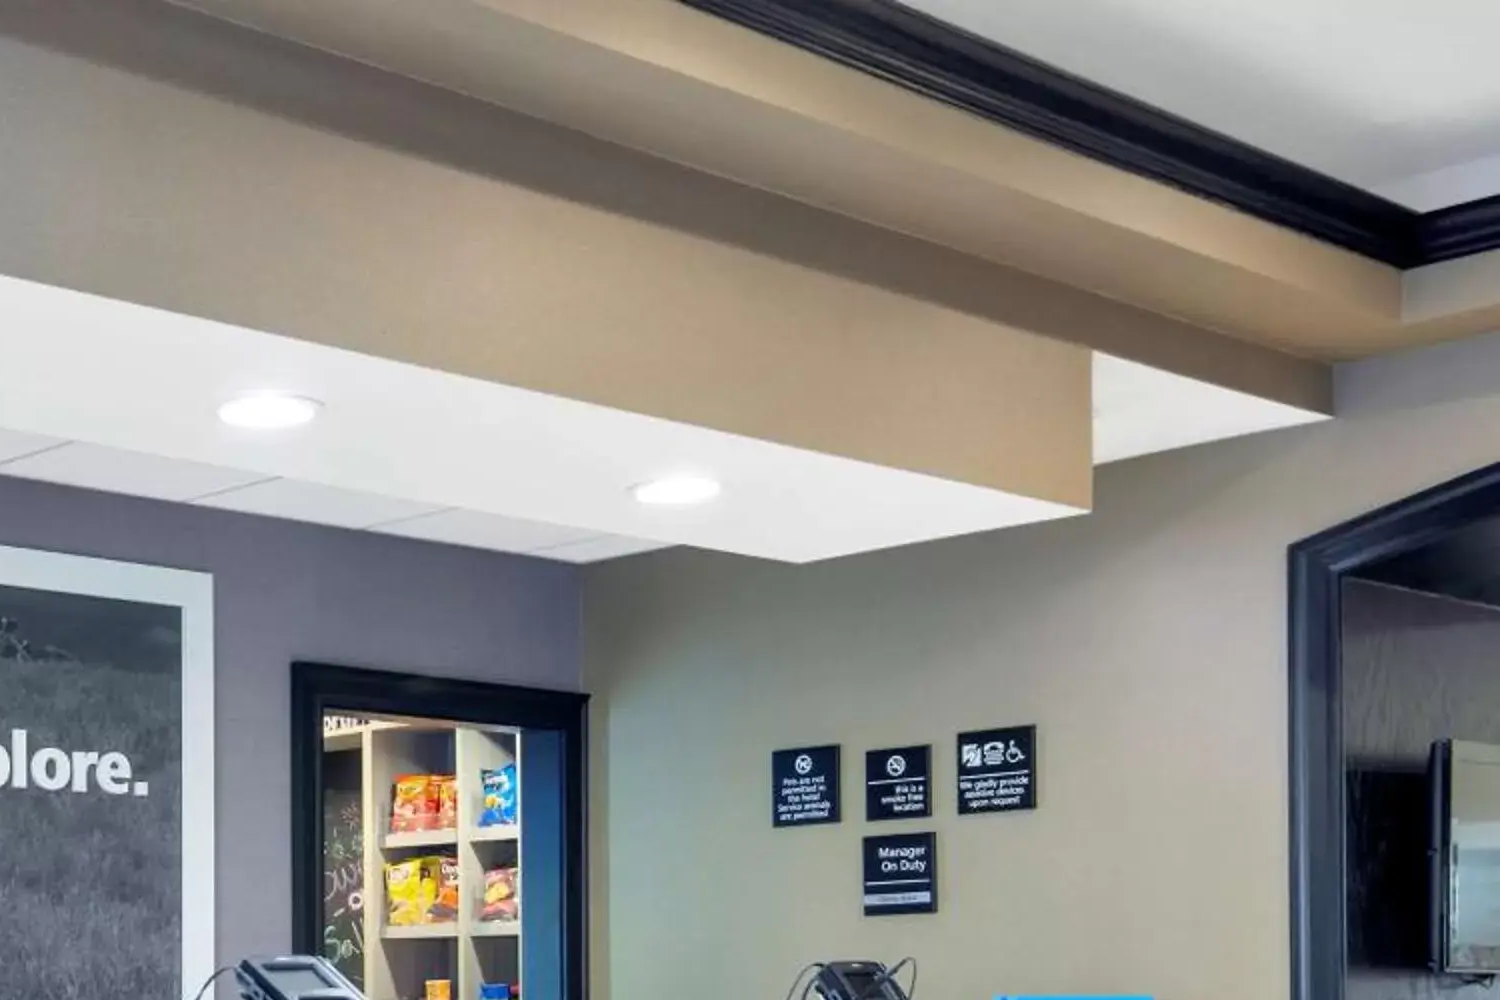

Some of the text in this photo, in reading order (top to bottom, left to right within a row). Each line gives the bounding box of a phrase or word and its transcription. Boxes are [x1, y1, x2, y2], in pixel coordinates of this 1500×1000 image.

[878, 846, 926, 860] Manager
[881, 859, 927, 873] On Duty
